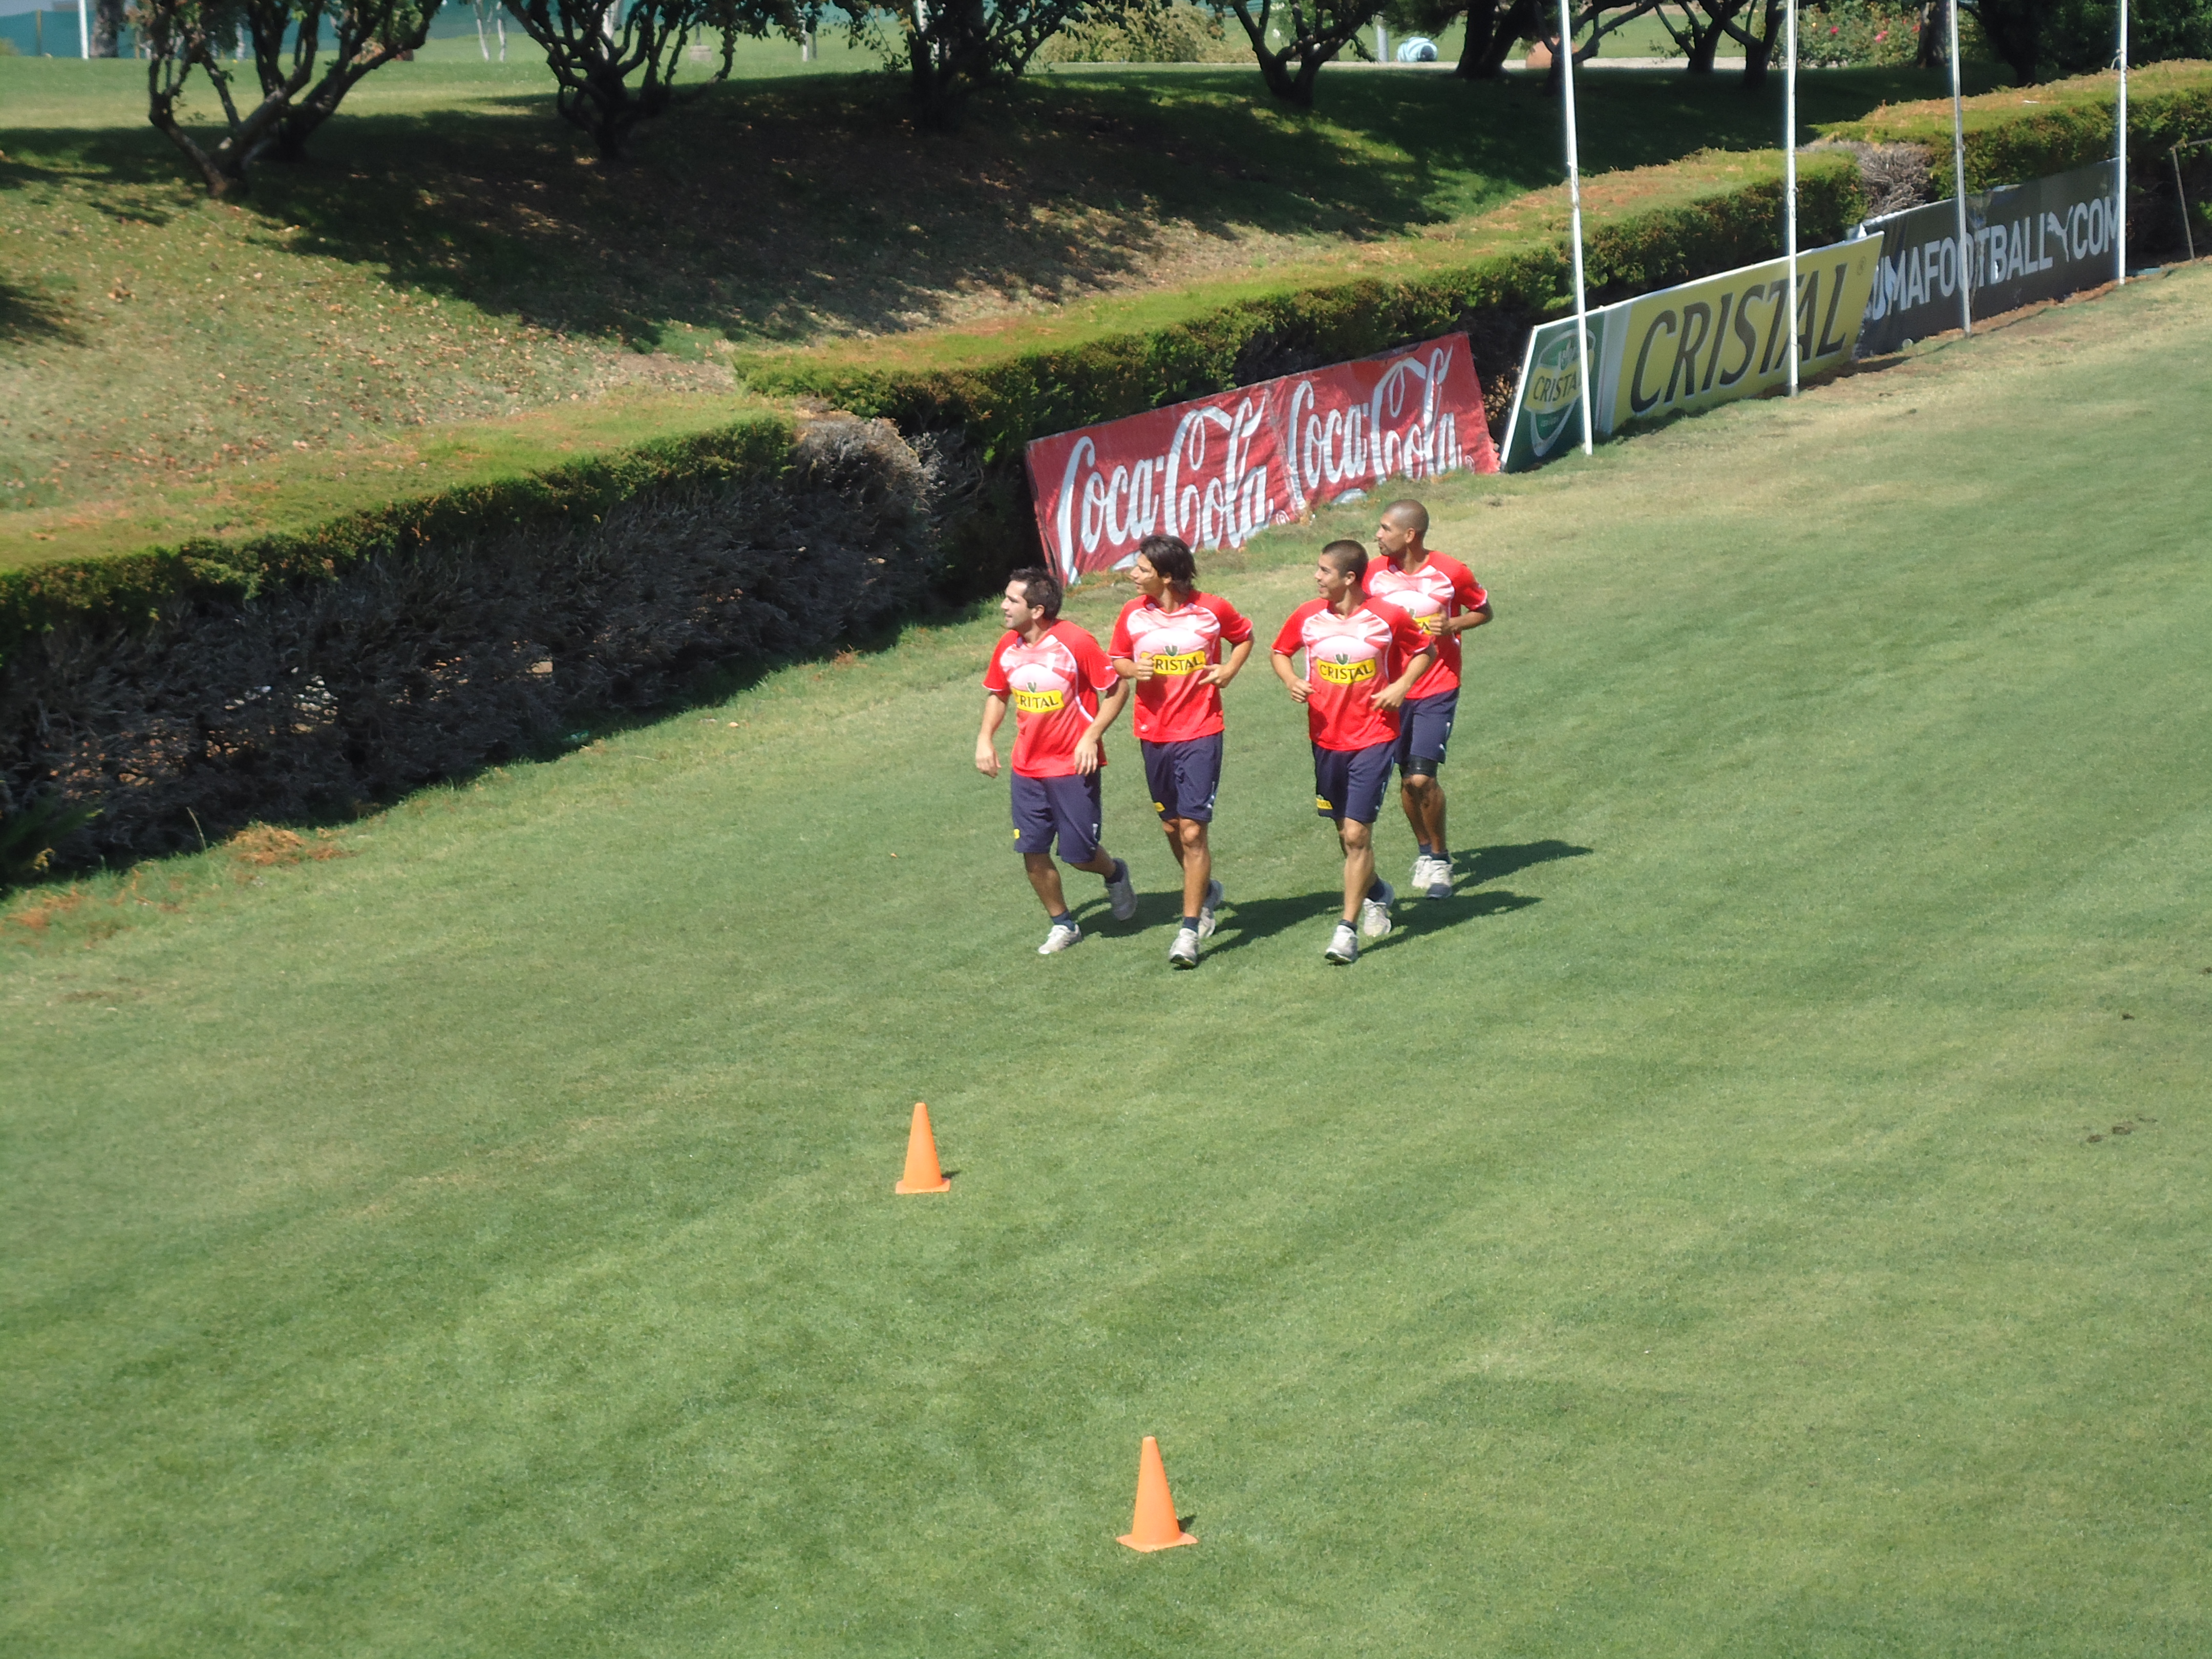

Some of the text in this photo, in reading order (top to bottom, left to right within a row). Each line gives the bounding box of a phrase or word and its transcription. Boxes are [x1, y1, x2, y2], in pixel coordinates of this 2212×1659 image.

[1862, 212, 2053, 321] UMAFOOTBALL
[1533, 370, 1581, 403] CRISTA
[1630, 263, 1848, 413] CRISTAL
[1287, 344, 1462, 509] Coca-Cola
[1057, 394, 1274, 585] Coca-Cola
[1150, 656, 1203, 671] RISTAL
[1320, 664, 1373, 680] CRISTAL
